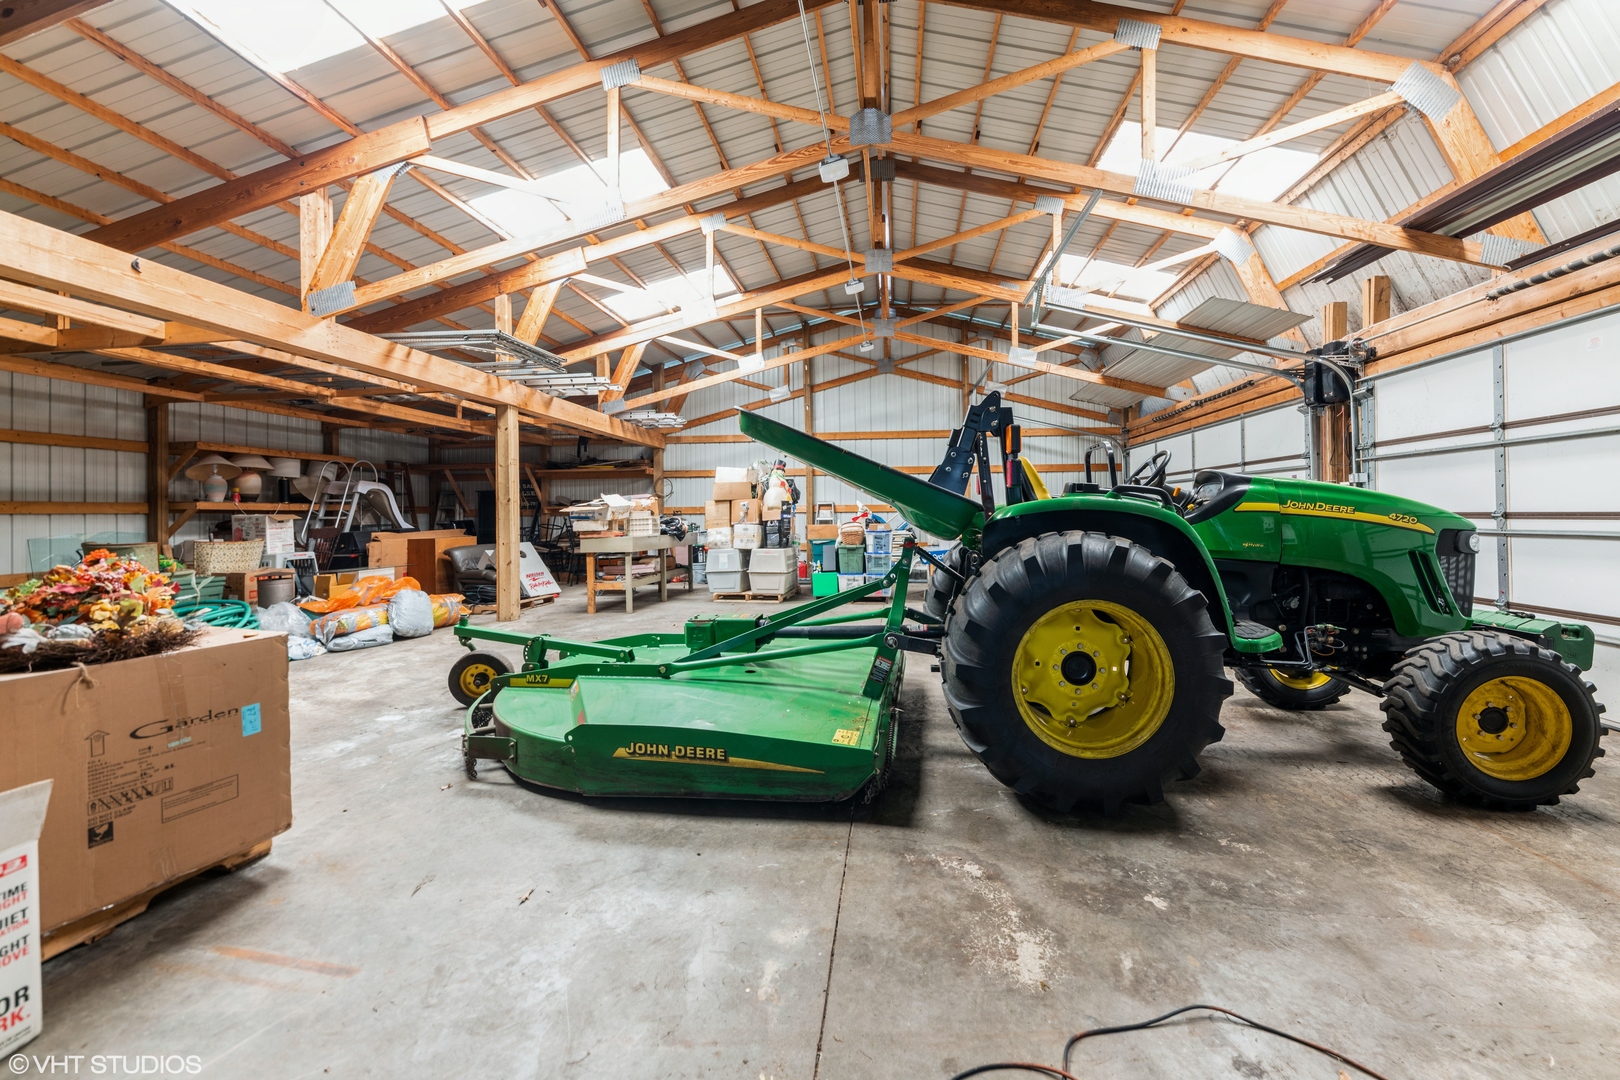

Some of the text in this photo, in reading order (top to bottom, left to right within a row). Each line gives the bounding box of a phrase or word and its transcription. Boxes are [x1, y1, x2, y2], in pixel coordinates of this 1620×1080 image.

[1282, 500, 1355, 514] JOHN DEERE
[1389, 513, 1418, 524] 4720
[526, 674, 549, 684] MX7
[129, 707, 239, 740] Garden
[625, 742, 727, 760] JOHN DEERE
[0, 881, 28, 901] IME
